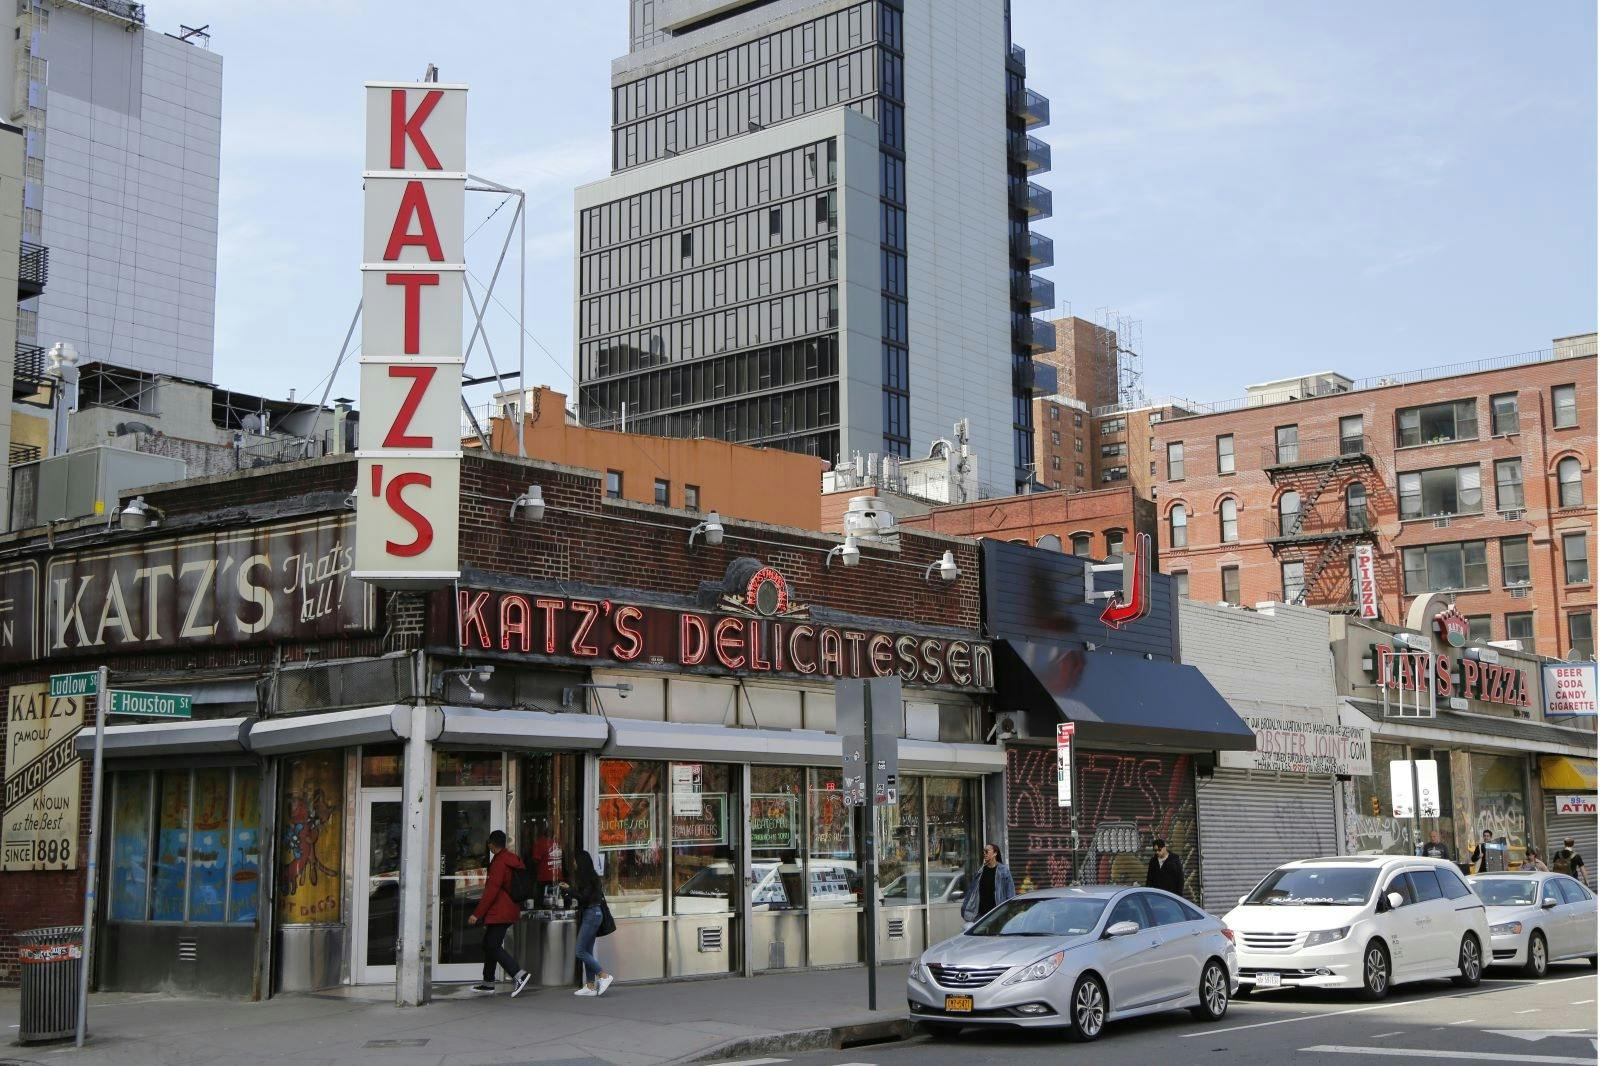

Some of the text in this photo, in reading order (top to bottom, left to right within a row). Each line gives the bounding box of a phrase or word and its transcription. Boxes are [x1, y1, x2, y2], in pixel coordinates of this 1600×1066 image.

[371, 89, 445, 557] KATZ'S
[1360, 556, 1377, 618] PIZZA
[51, 554, 275, 649] KATZ'S
[459, 589, 995, 688] KATZ'S DELICATESSEN
[1462, 658, 1534, 708] PIZZA
[1557, 668, 1583, 678] BEER
[51, 674, 98, 696] Ludlow St
[1557, 680, 1583, 689] SODA
[110, 693, 189, 714] E Houston St
[1555, 690, 1587, 700] CANDY
[1550, 701, 1595, 711] CIGARETTE
[1256, 730, 1307, 758] OBSTER
[1312, 735, 1349, 760] JOINT
[33, 796, 70, 810] KNOWN
[1561, 803, 1597, 812] ATM
[12, 812, 64, 832] as the Best
[5, 848, 30, 863] SINCE
